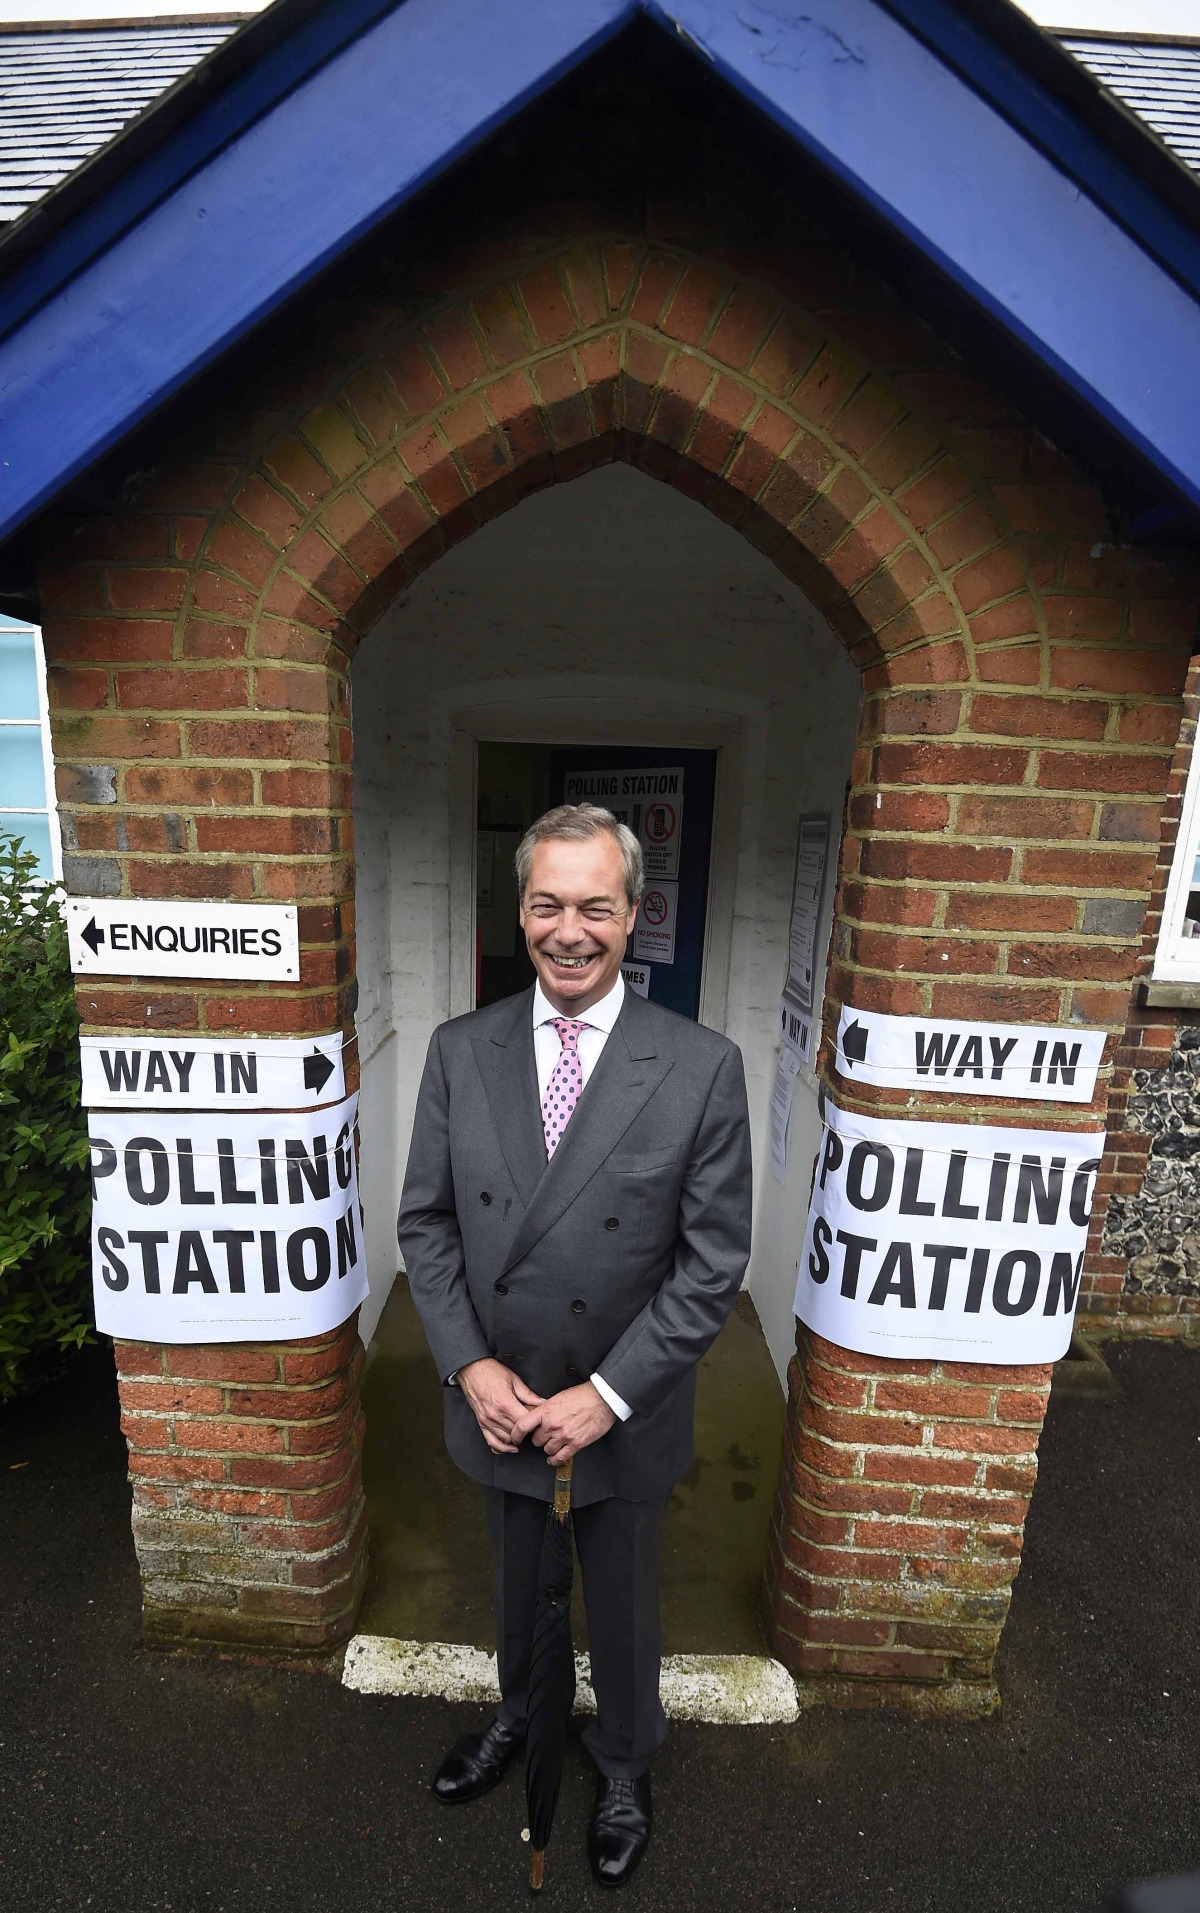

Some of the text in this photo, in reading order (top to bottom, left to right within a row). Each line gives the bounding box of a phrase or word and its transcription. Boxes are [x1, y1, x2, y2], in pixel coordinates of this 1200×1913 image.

[567, 774, 679, 795] POLLING STATION
[110, 923, 282, 956] ENQUIRIES
[646, 930, 671, 939] SMOKING
[99, 1050, 258, 1094] WAY IN
[914, 1031, 1082, 1086] WAY IN
[88, 1121, 352, 1206] POLLING
[98, 1202, 358, 1294] STATION
[808, 1215, 1085, 1318] STATION
